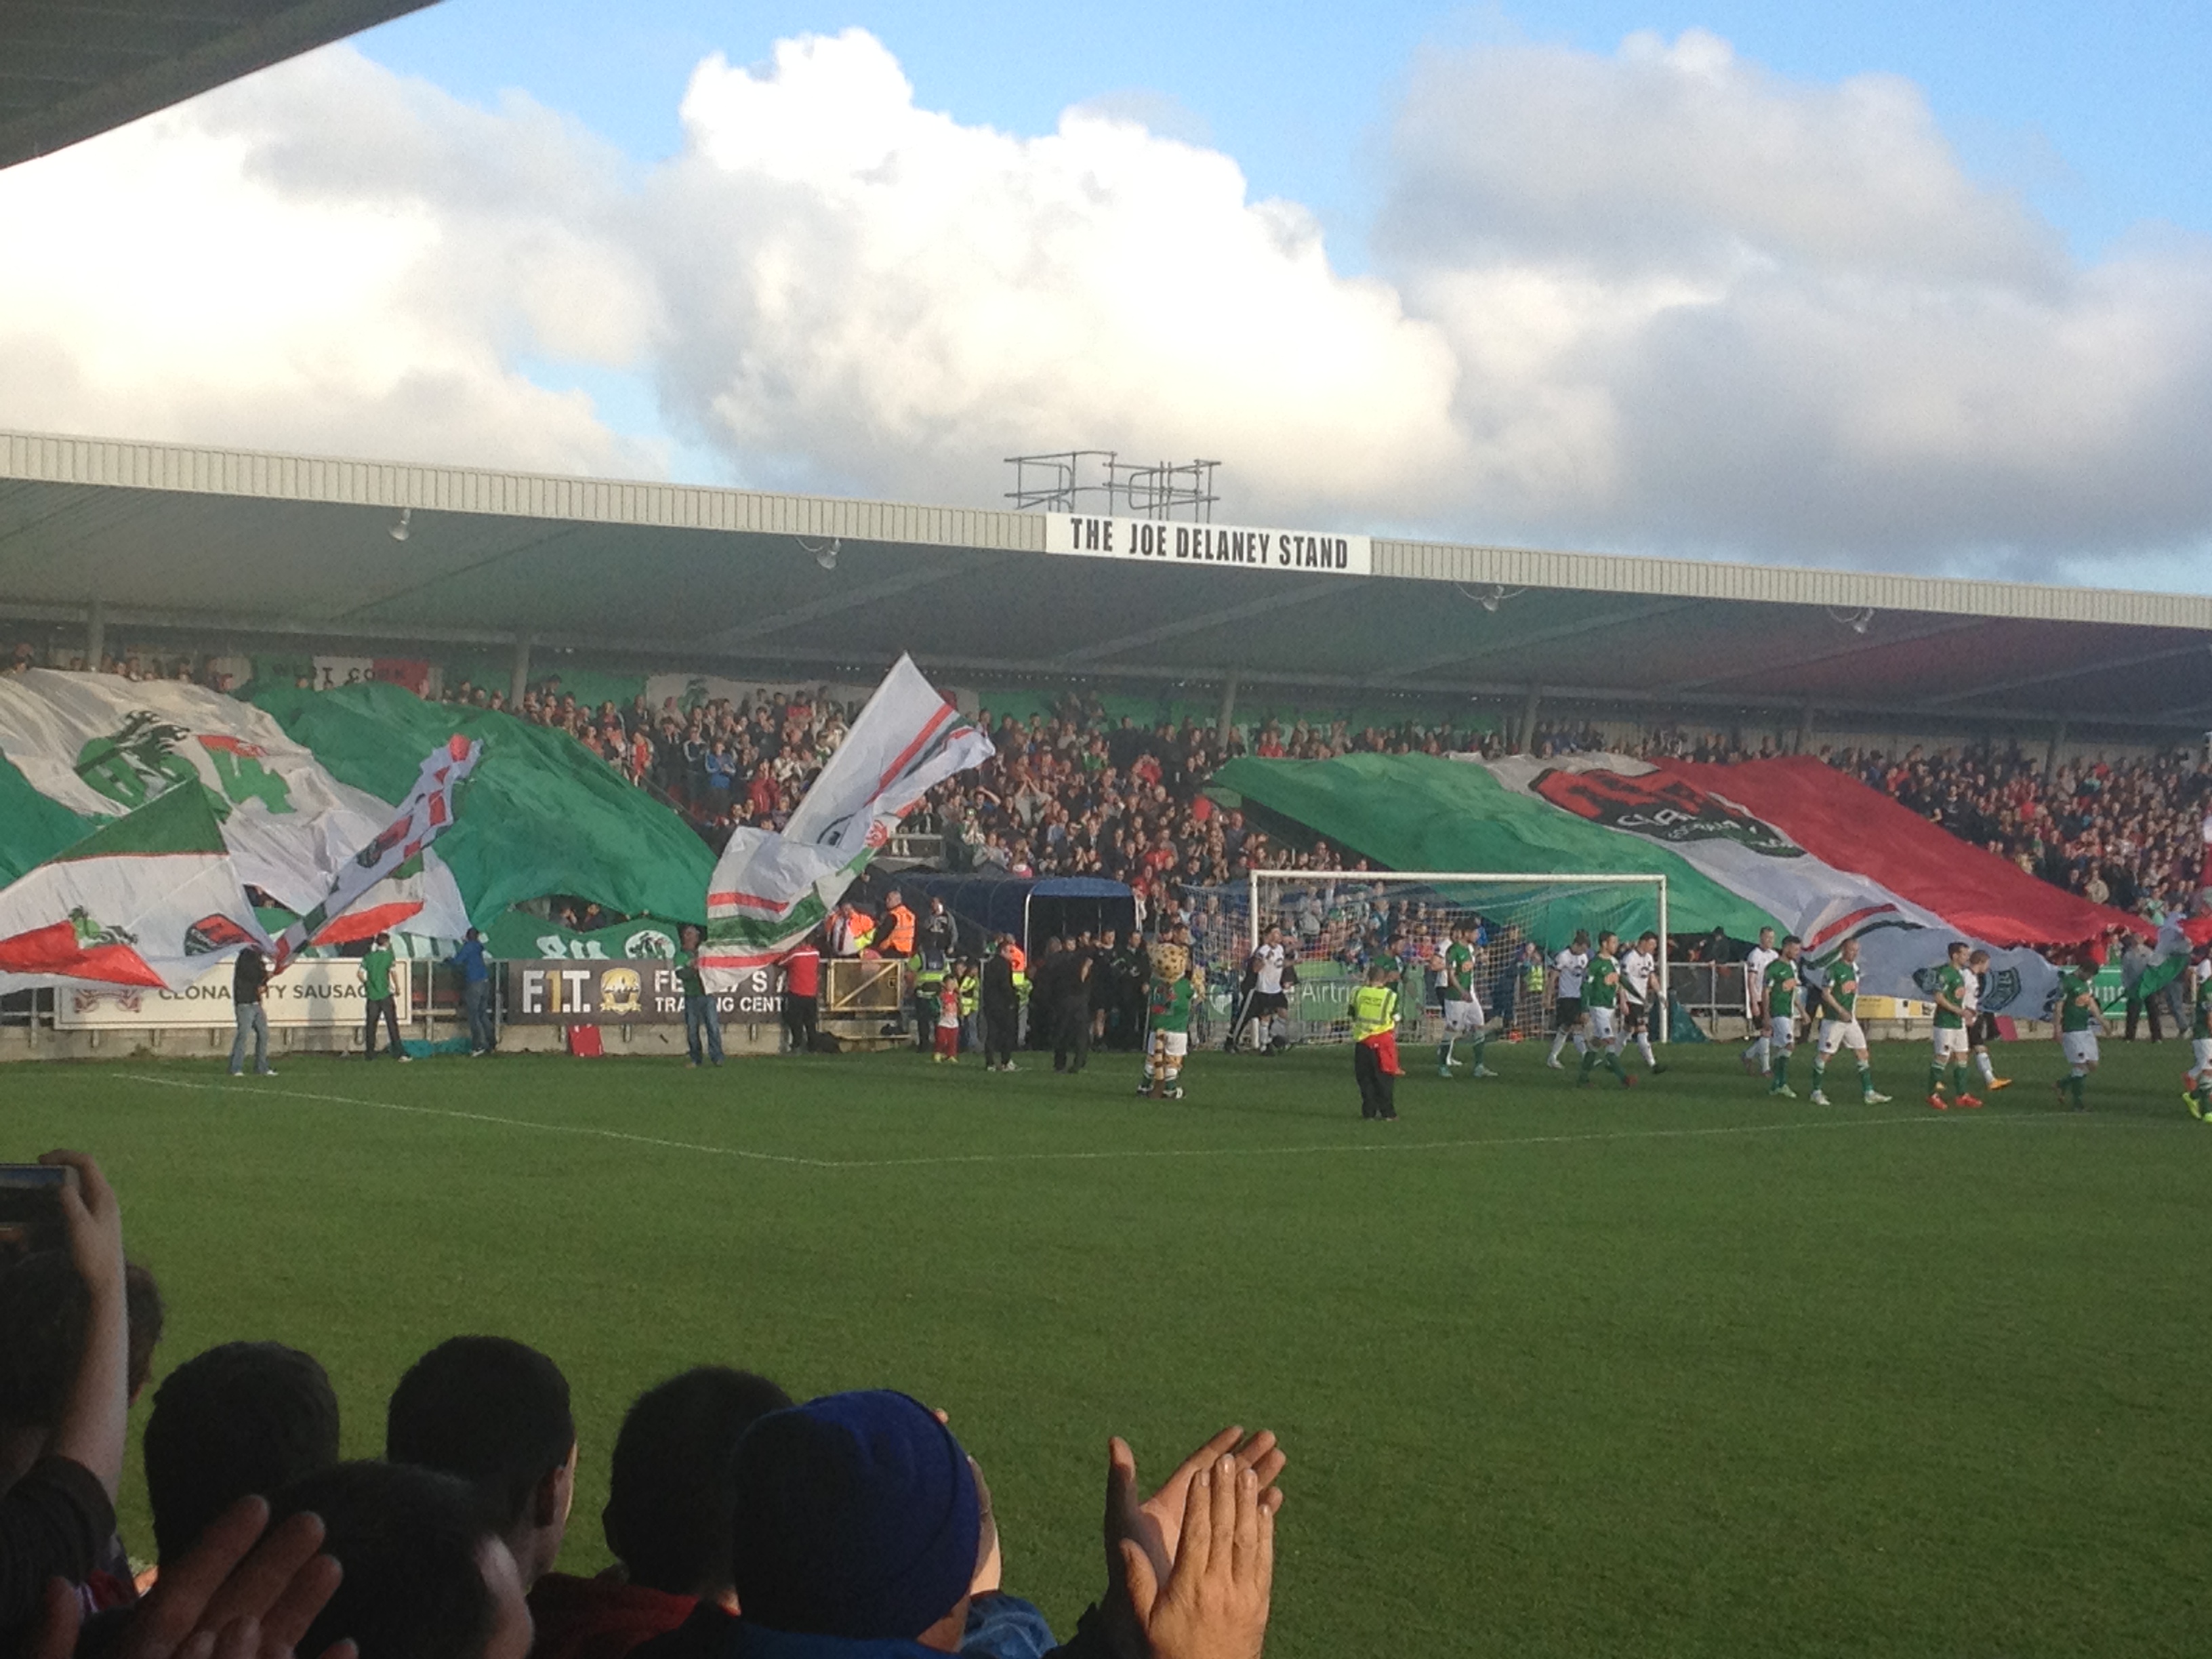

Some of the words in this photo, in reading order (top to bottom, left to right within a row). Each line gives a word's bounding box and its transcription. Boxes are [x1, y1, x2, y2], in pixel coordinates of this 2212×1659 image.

[1071, 518, 1113, 552] THE
[1130, 524, 1167, 556] JOE
[1176, 527, 1271, 564] DELANEY
[1279, 534, 1348, 569] STAND
[159, 984, 287, 1002] CLONATY
